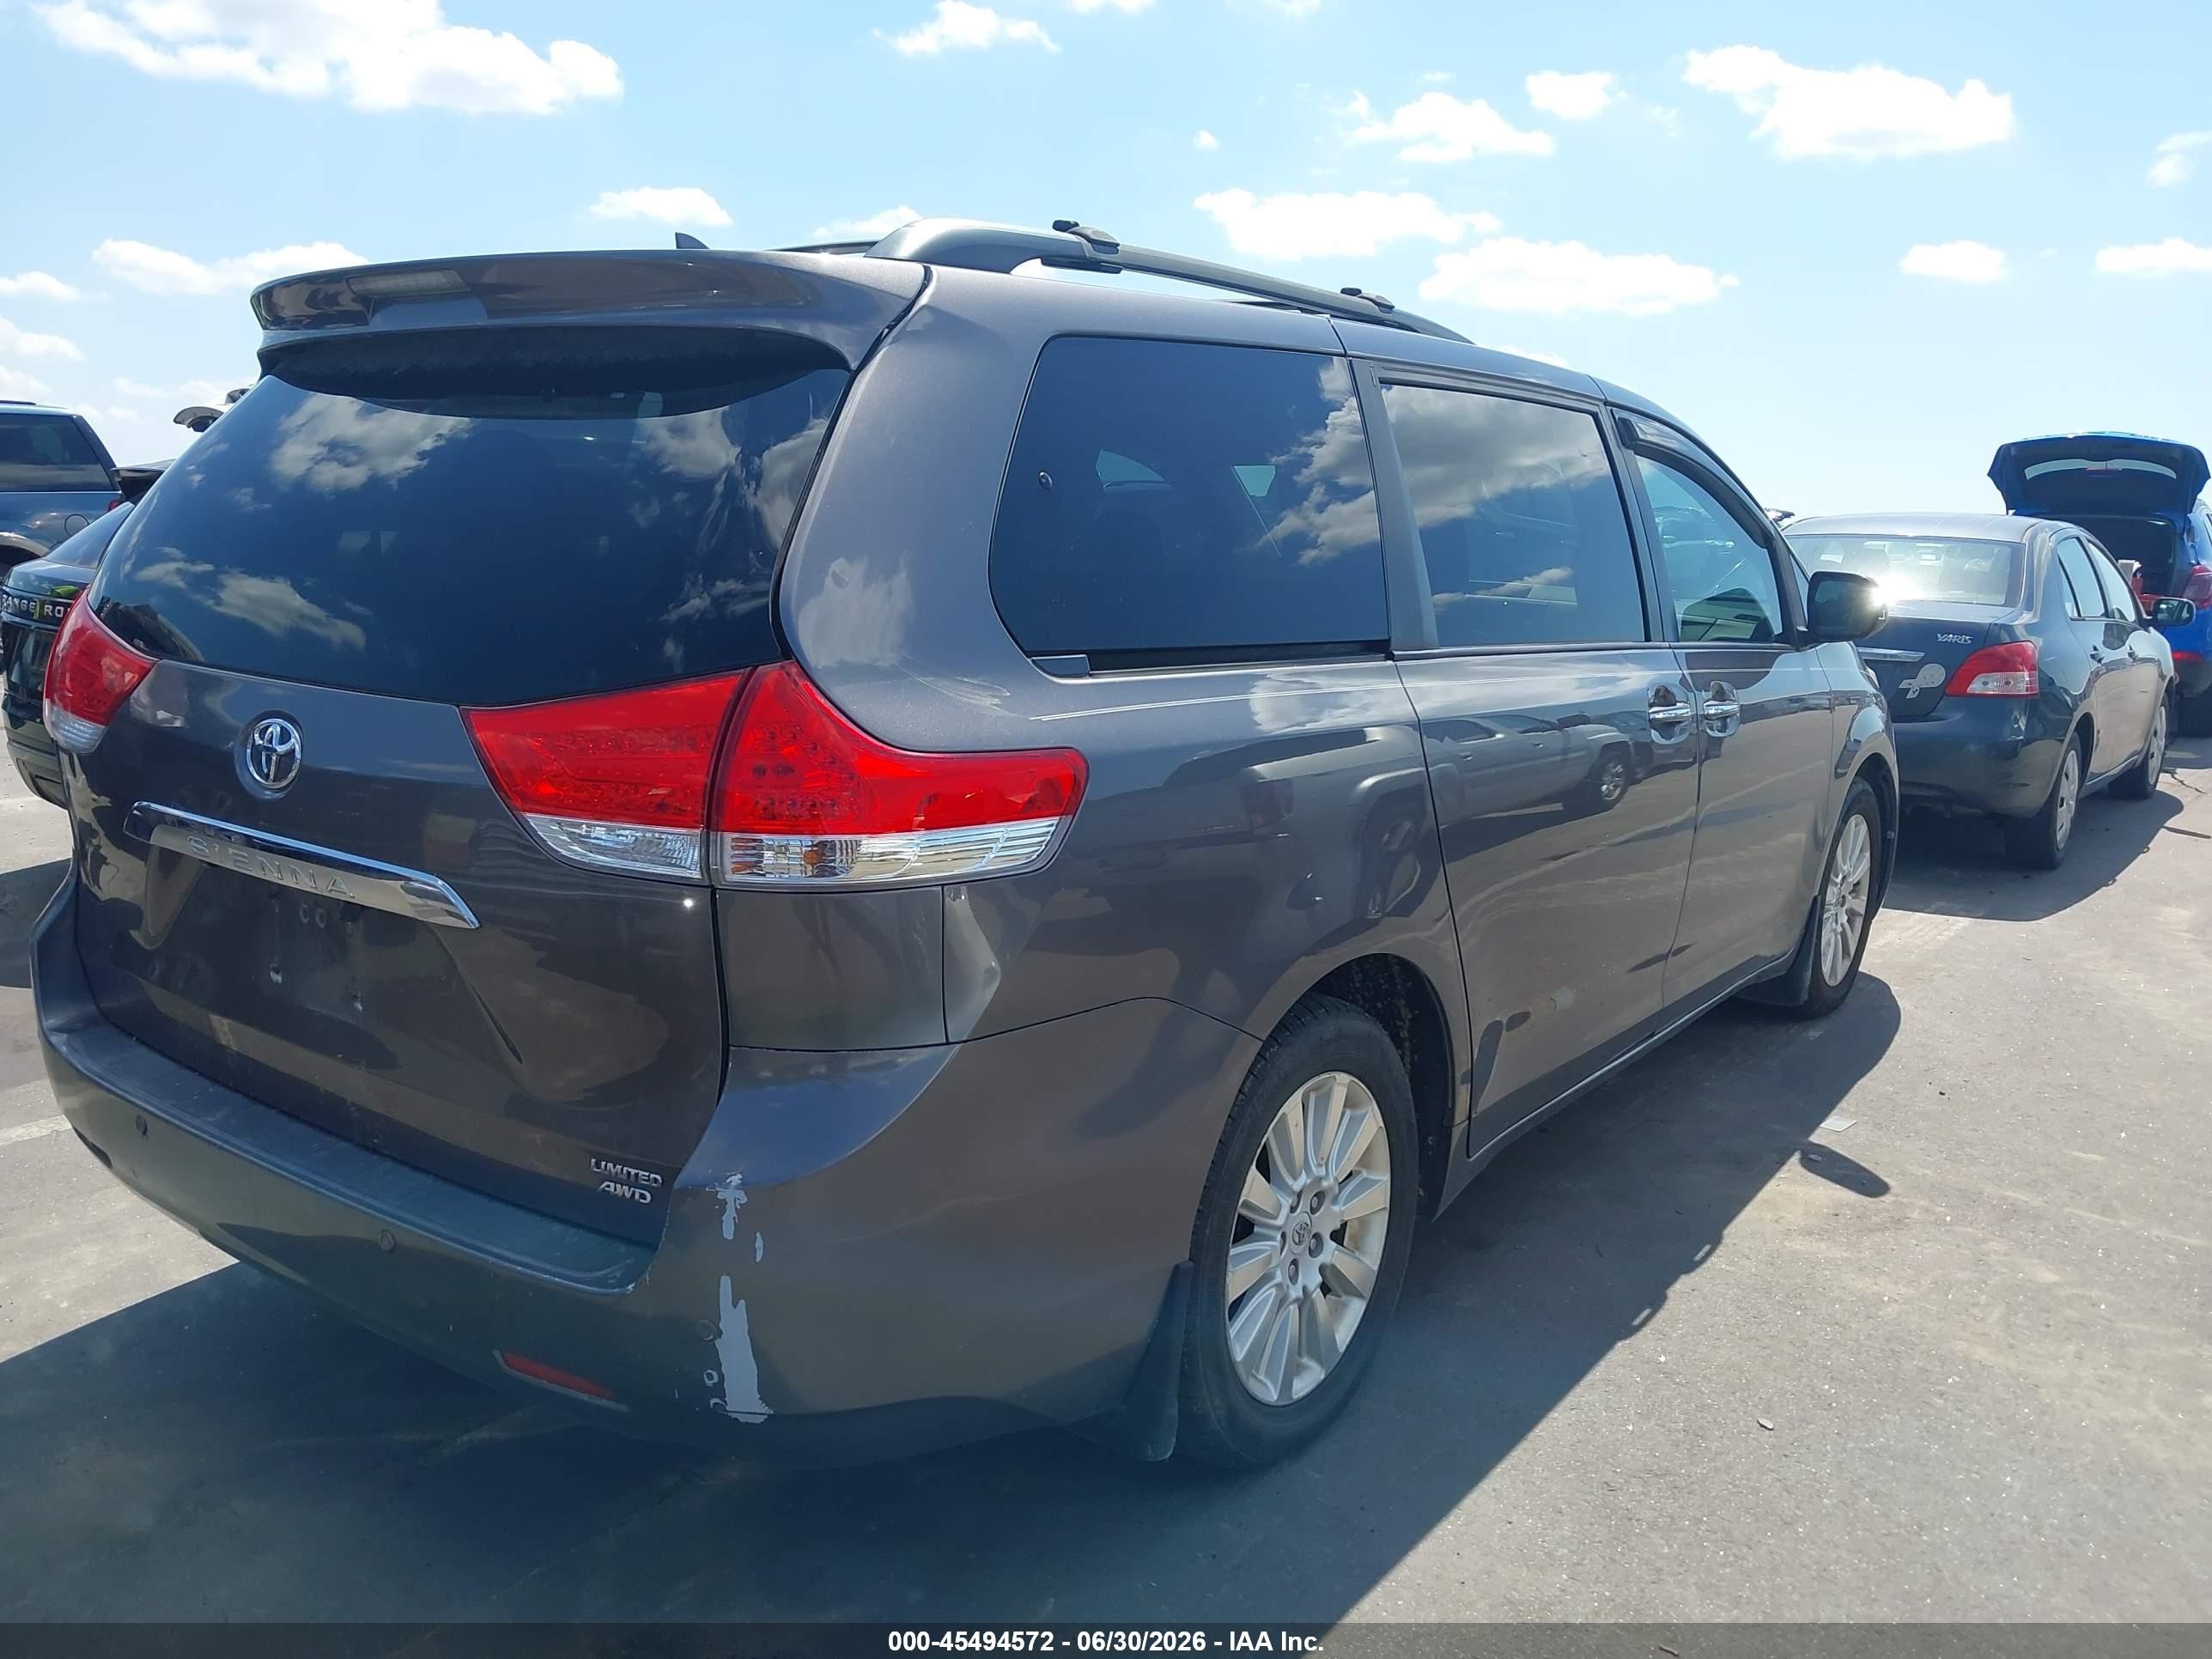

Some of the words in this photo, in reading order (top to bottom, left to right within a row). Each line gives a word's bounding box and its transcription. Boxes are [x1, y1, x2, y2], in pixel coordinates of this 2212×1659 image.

[2, 594, 36, 612] RANGE
[44, 604, 70, 617] RO
[1936, 633, 1974, 644] YARIS
[590, 1158, 662, 1188] LIMITED
[598, 1181, 652, 1204] AWD
